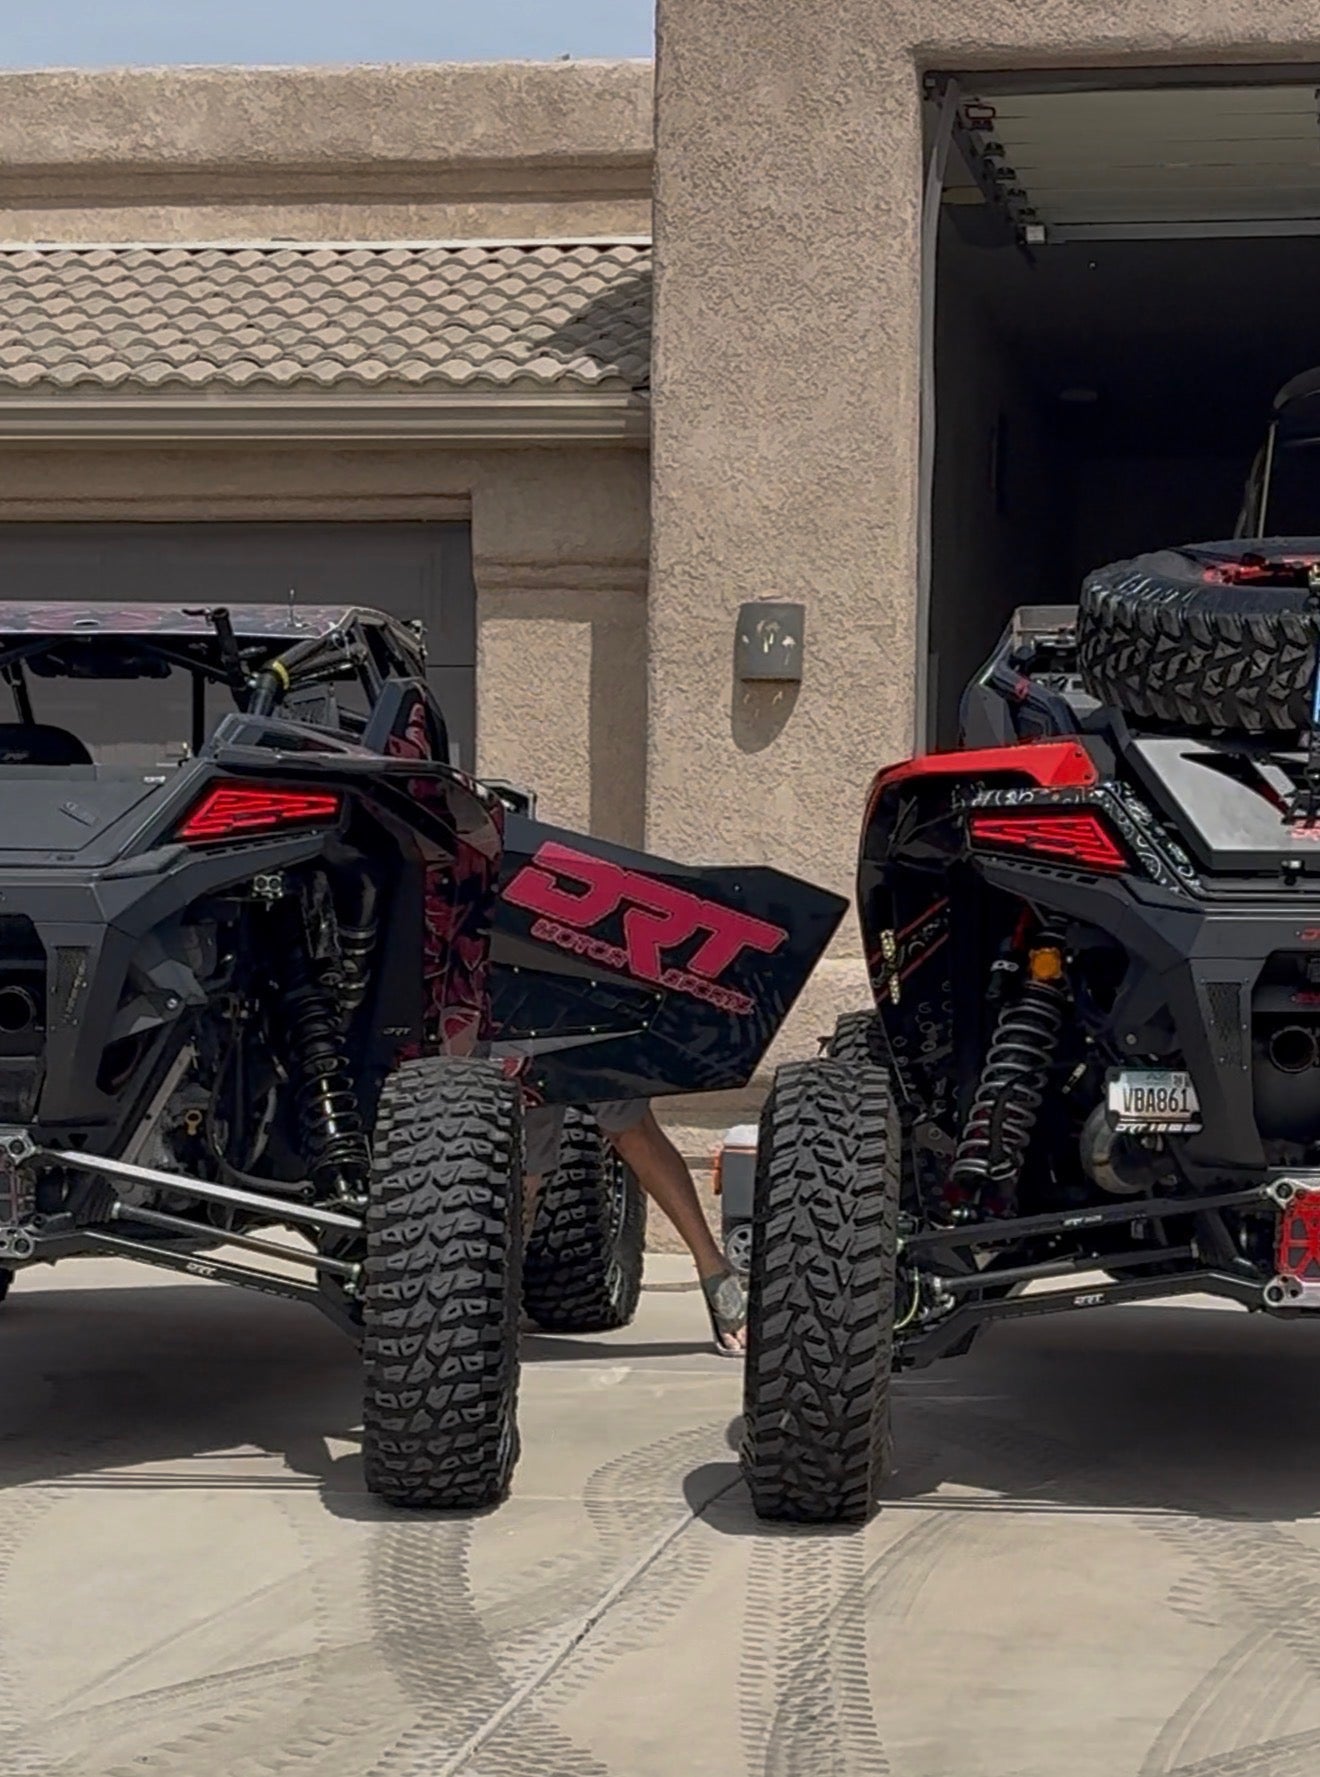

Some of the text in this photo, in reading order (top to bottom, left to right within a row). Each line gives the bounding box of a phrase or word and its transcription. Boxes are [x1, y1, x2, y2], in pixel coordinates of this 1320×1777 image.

[502, 841, 788, 981] DRT
[530, 918, 628, 969] MOTOR
[1122, 1087, 1190, 1113] VBA861
